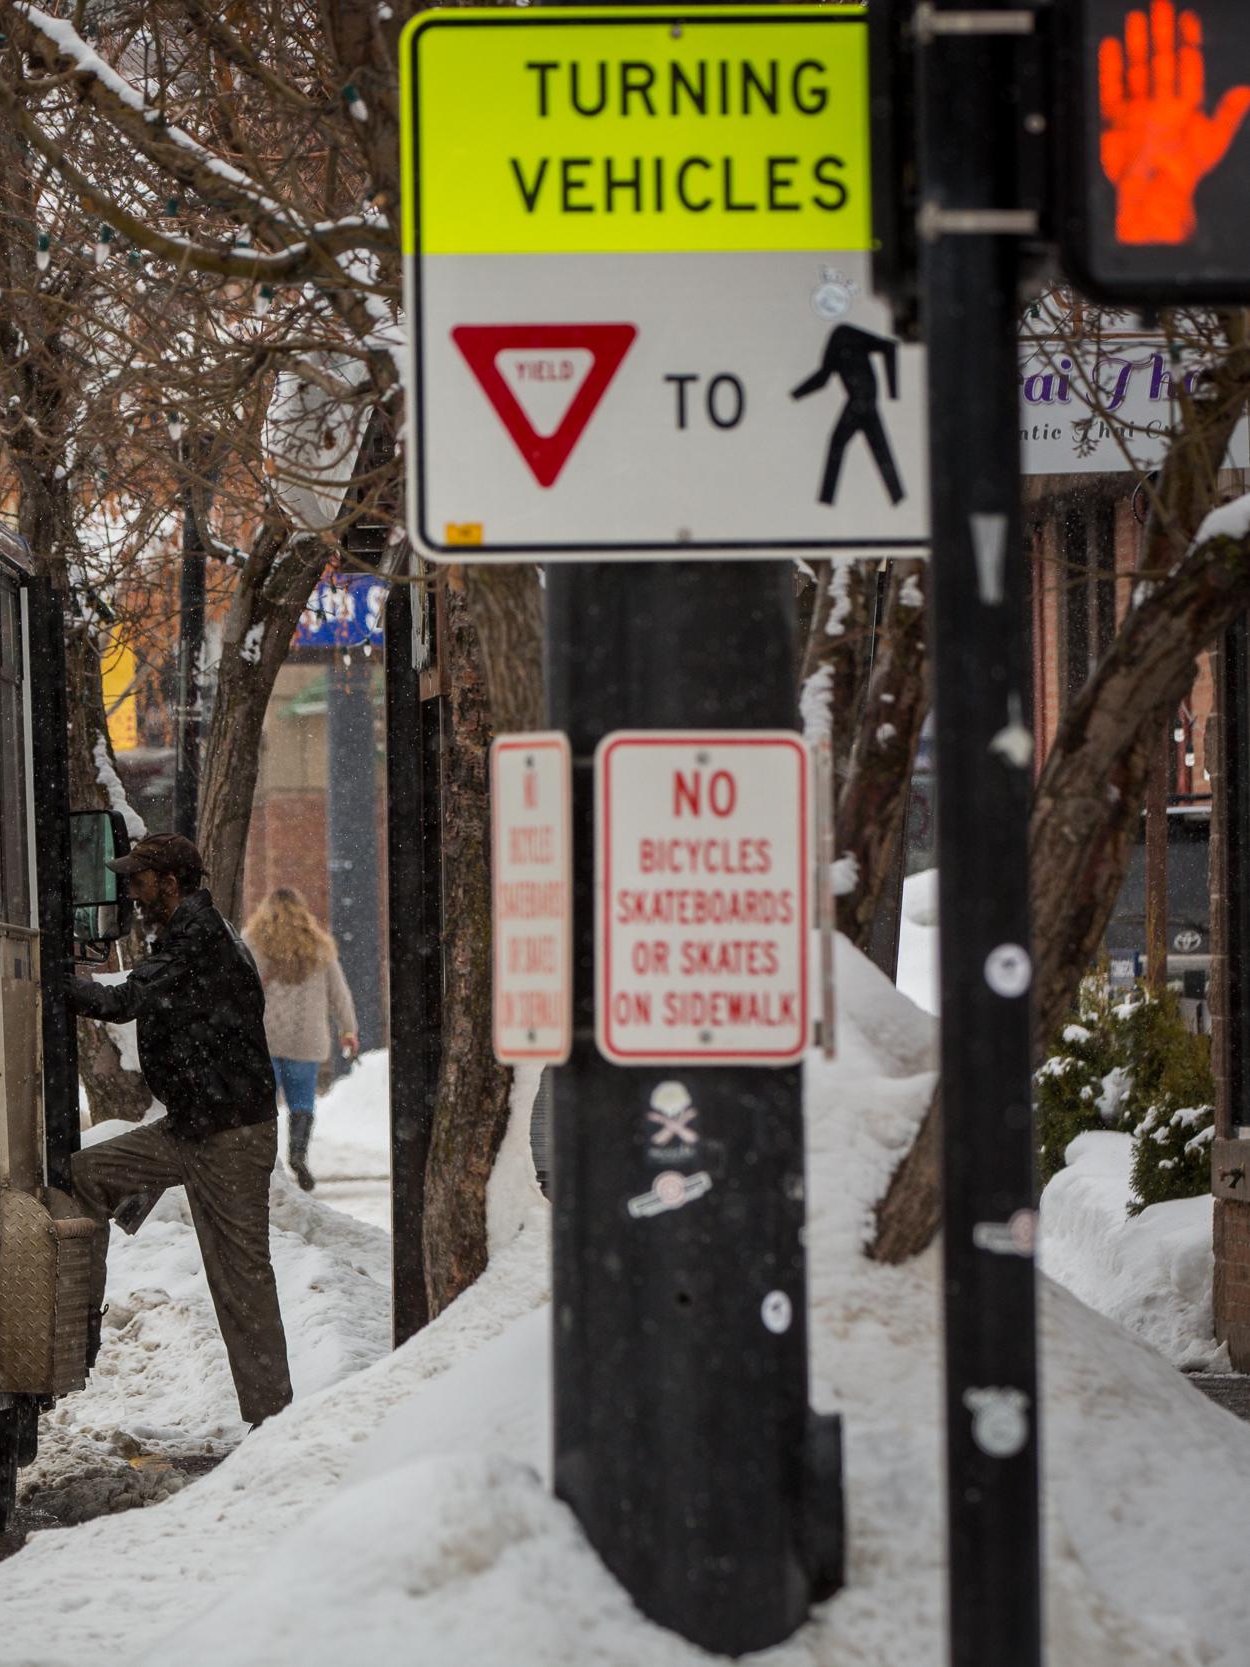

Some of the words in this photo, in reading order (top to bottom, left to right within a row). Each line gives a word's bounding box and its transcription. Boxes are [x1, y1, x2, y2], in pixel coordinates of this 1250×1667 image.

[524, 60, 831, 118] TURNING
[510, 155, 850, 214] VEHICLES
[515, 360, 575, 383] YIELD
[664, 372, 747, 431] TO
[672, 769, 738, 819] NO
[638, 838, 772, 875] BICYCLES
[616, 889, 794, 926] SKATEBOARDS
[631, 940, 669, 977] OR
[680, 940, 780, 977] SKATES
[613, 991, 652, 1028] ON
[663, 991, 799, 1028] SIDEWALK
